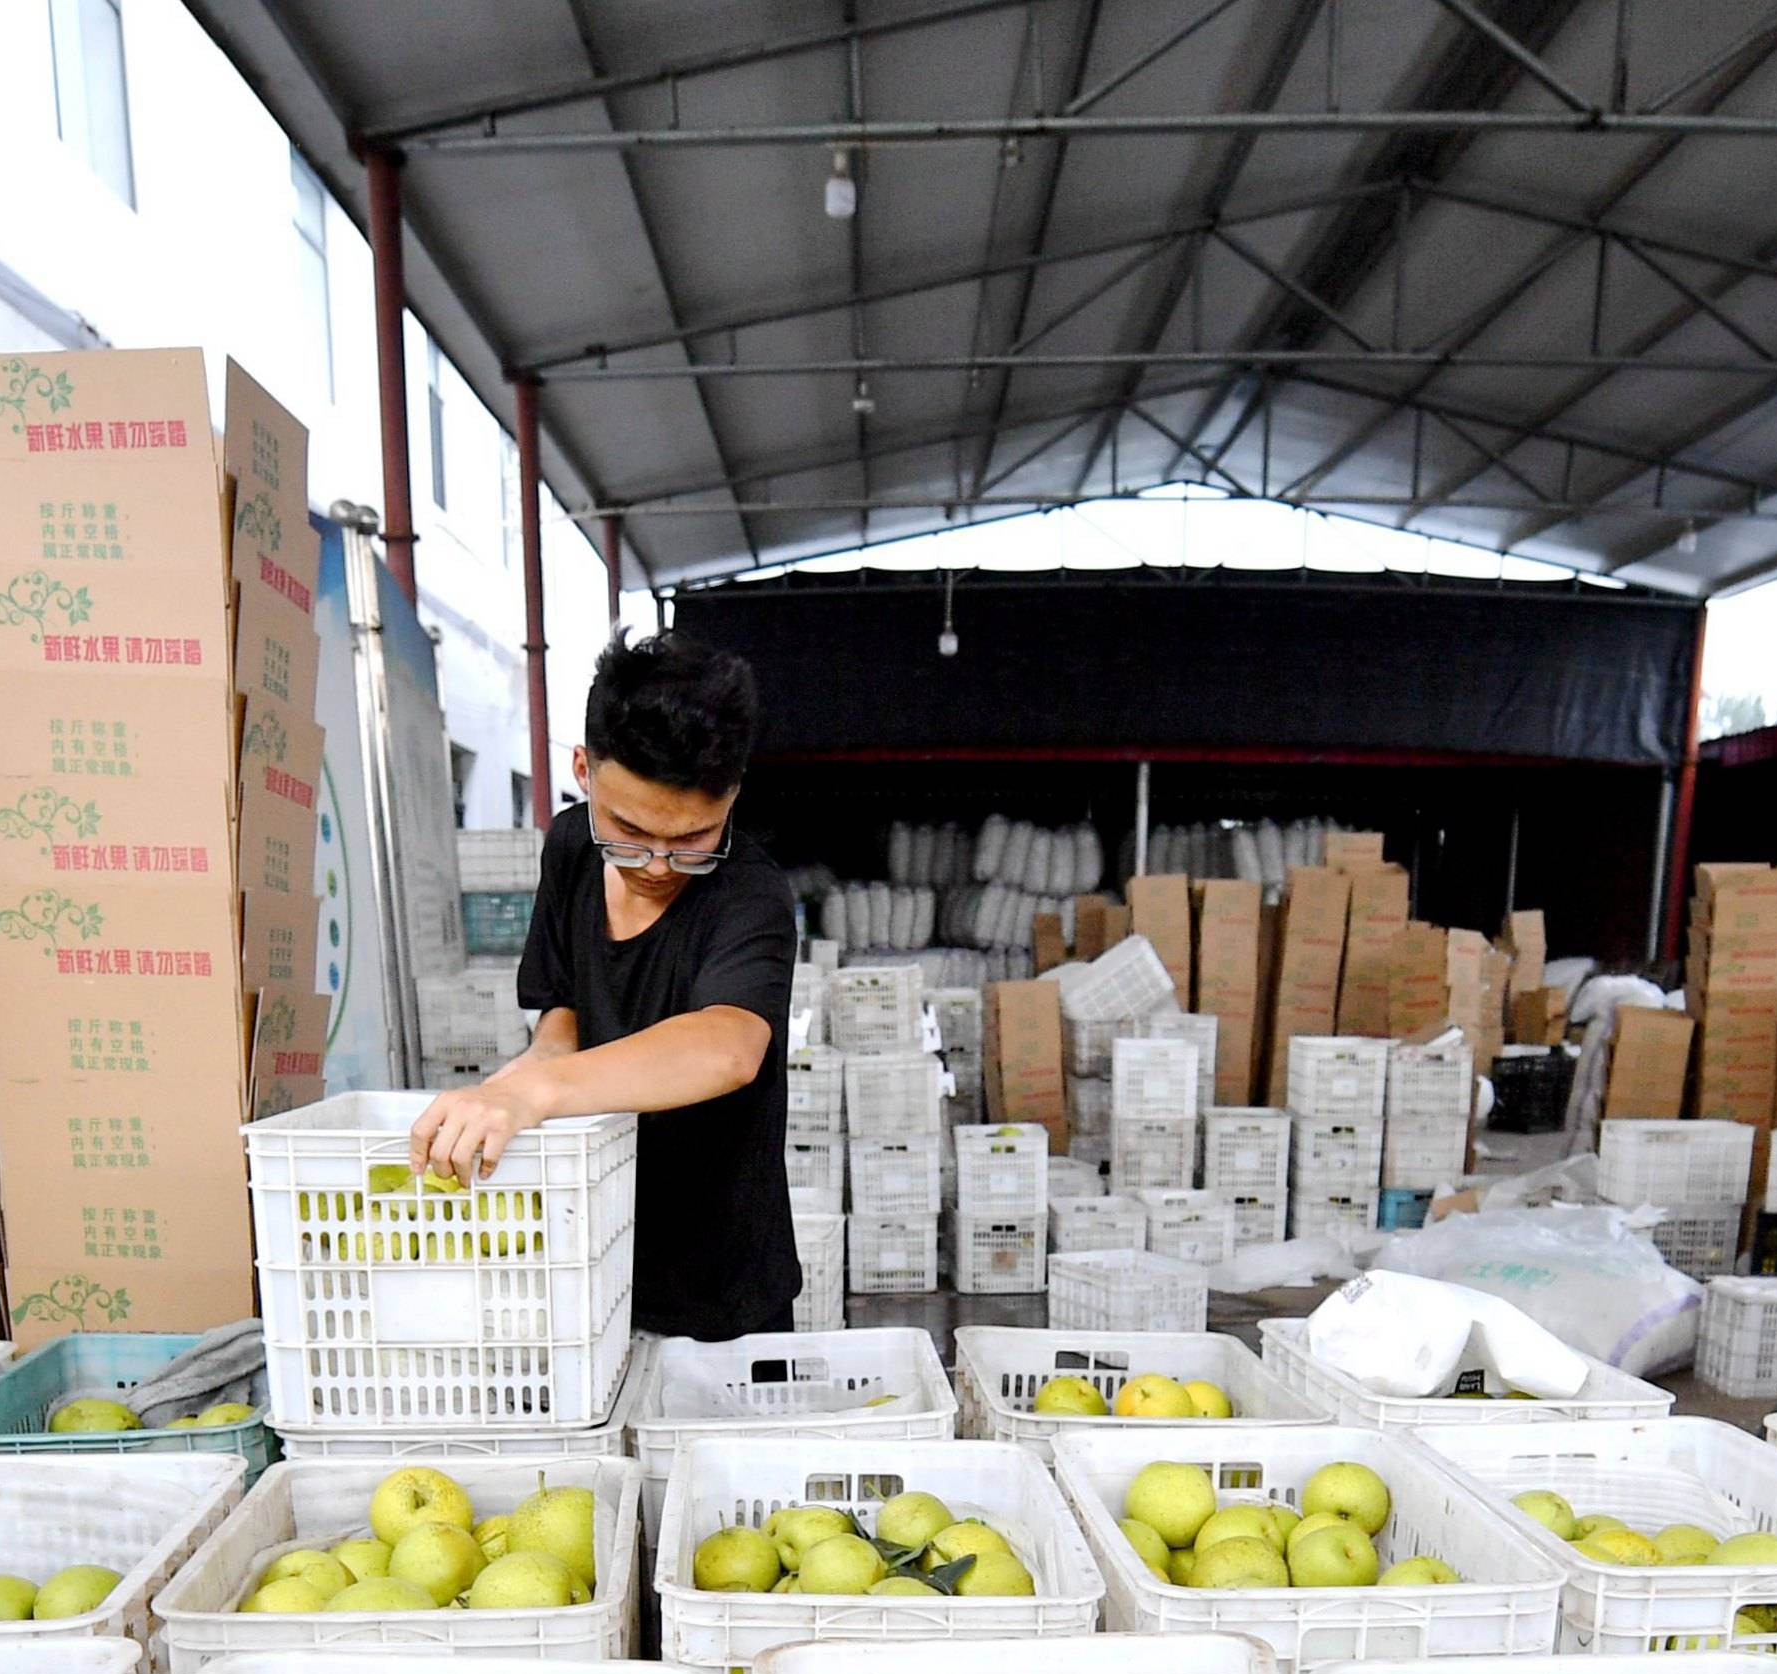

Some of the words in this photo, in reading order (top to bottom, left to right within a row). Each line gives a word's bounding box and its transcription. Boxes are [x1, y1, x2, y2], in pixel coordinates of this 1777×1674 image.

[26, 421, 107, 455] 新鲜水果
[110, 419, 190, 450] 请勿踩踏
[44, 634, 122, 664] 新鲜水果
[125, 635, 205, 668] 请勿踩踏
[54, 844, 129, 872] 新鲜水果
[134, 846, 210, 875] 请勿踩踏
[57, 948, 134, 977] 新鲜水果
[138, 949, 214, 978] 请勿踩踏
